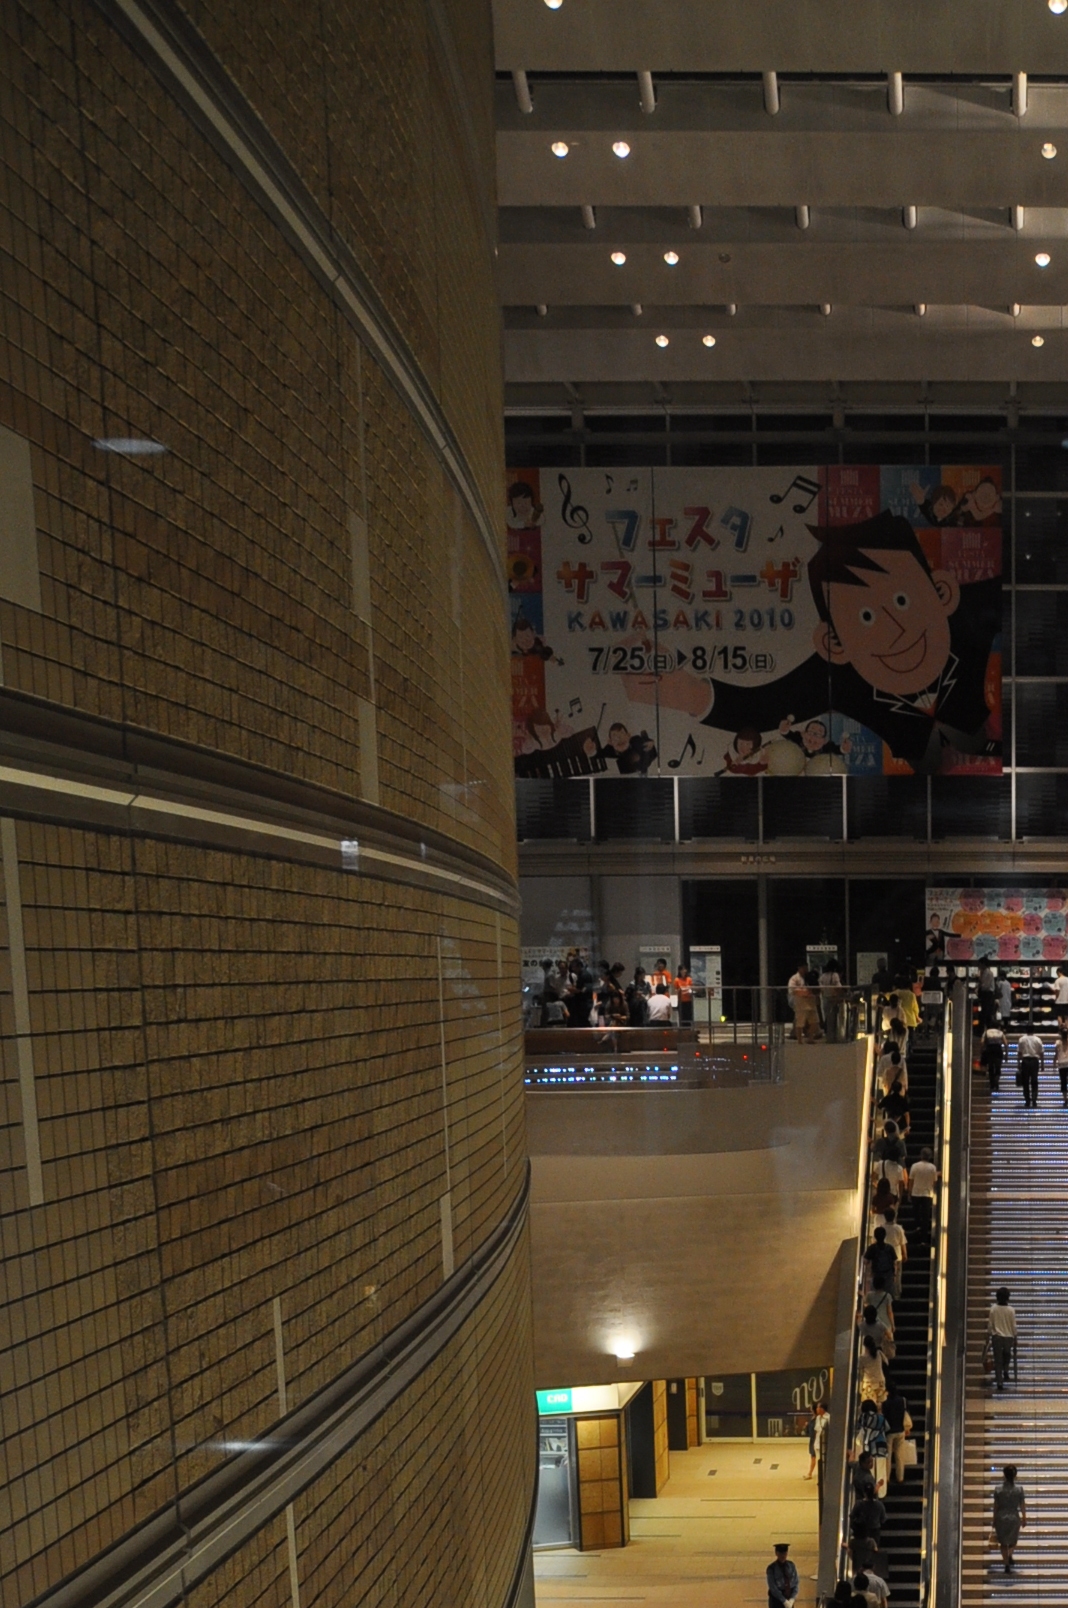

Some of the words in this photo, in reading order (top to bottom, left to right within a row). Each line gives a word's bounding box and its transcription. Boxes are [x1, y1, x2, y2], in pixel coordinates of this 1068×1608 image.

[604, 505, 752, 552] フェスタ
[556, 556, 802, 604] サマーミューザ
[567, 608, 723, 632] KAWASAKI
[734, 608, 795, 630] 2010
